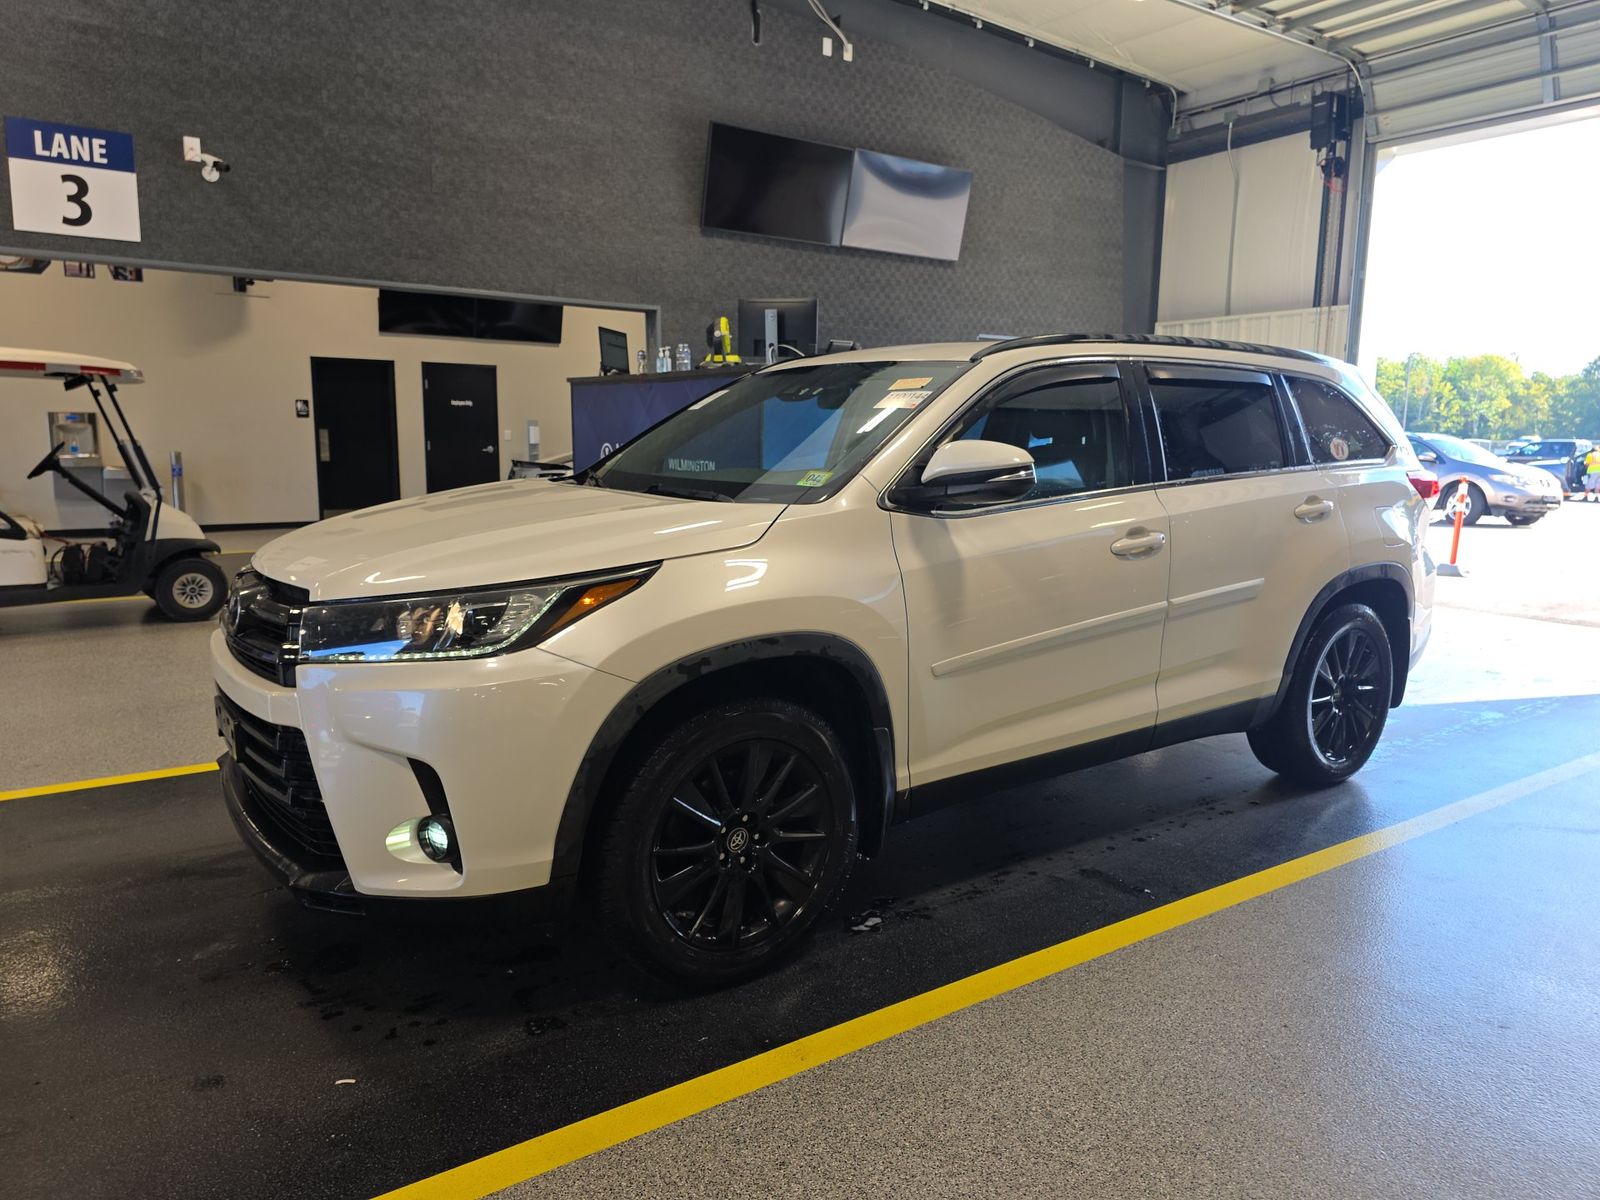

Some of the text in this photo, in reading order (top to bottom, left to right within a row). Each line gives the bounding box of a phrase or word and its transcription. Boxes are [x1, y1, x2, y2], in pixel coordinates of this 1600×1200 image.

[33, 129, 108, 164] LANE
[61, 174, 92, 227] 3
[668, 458, 716, 472] WILMINGTON
